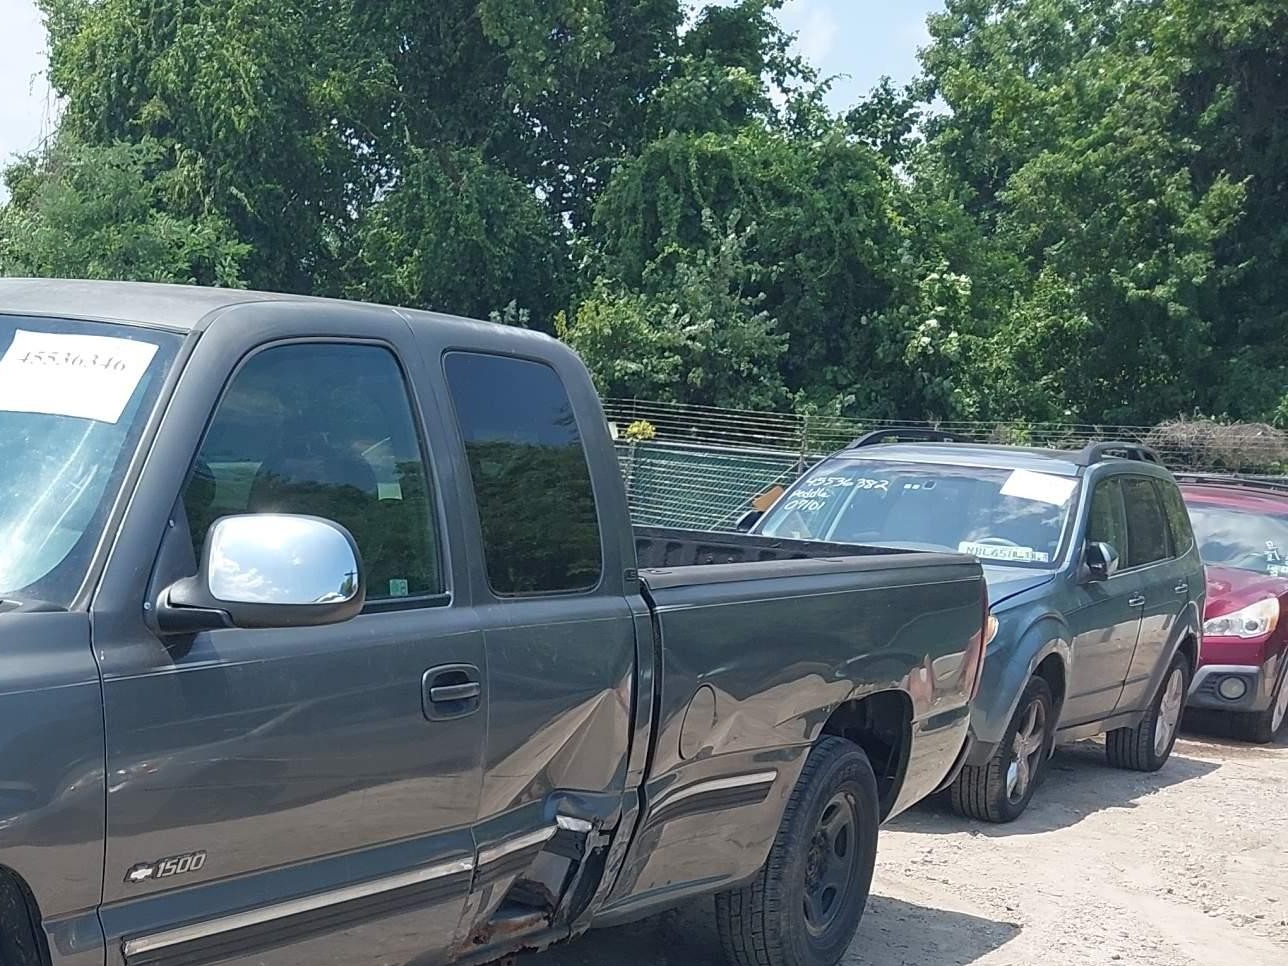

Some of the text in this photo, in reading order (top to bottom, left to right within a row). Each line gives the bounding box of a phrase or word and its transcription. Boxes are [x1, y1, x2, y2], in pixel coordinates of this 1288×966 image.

[16, 351, 126, 372] 45536346
[806, 477, 889, 492] 45536382
[156, 853, 207, 878] 1500
